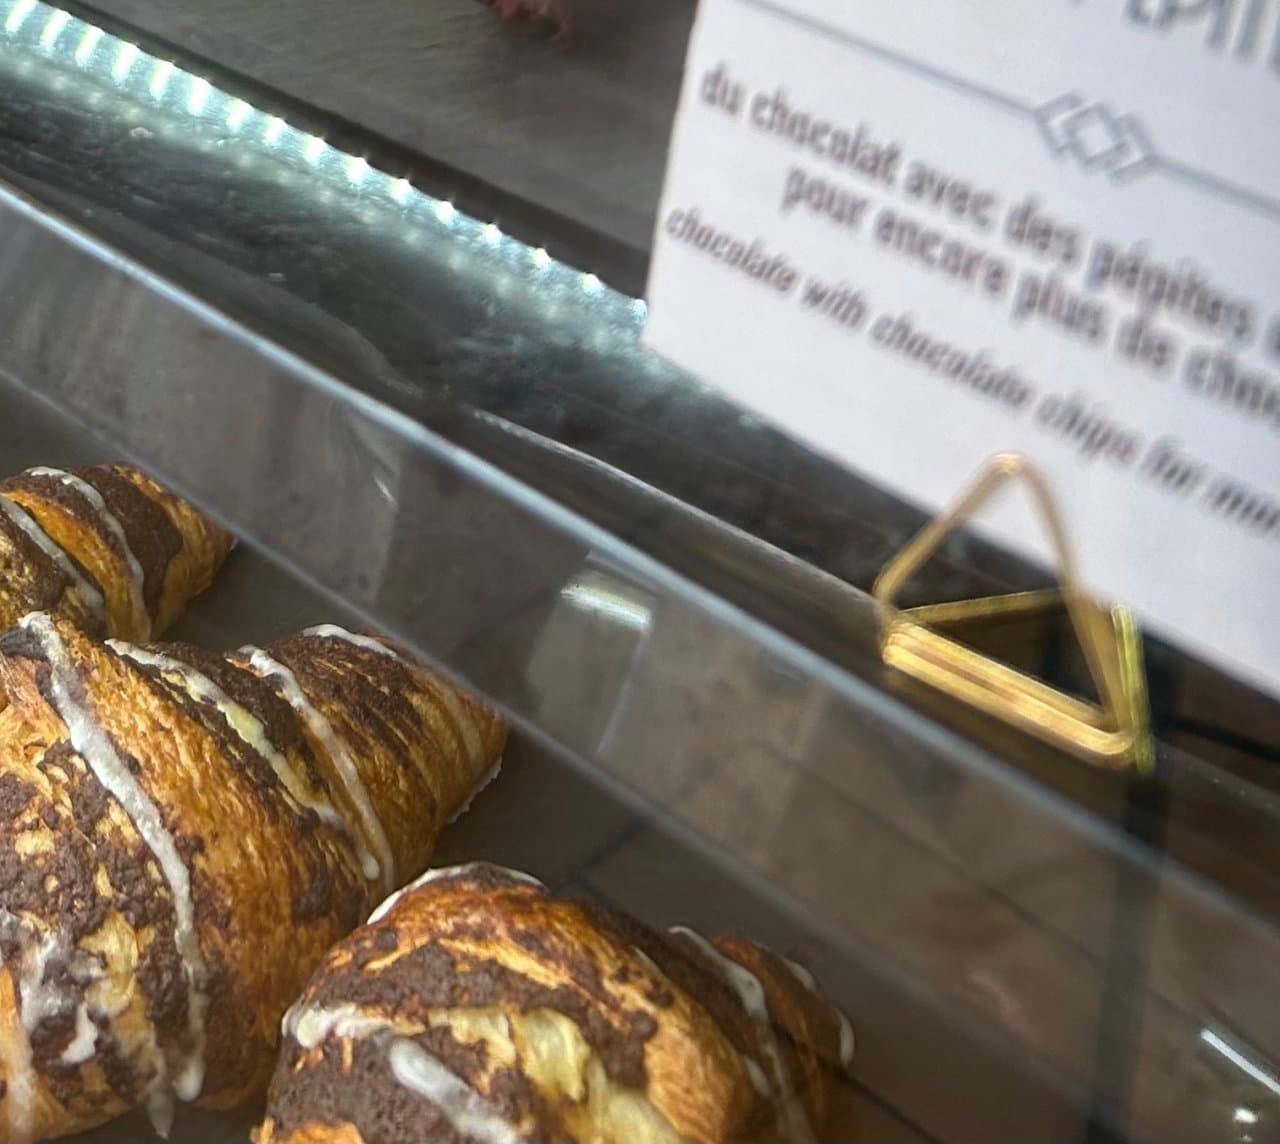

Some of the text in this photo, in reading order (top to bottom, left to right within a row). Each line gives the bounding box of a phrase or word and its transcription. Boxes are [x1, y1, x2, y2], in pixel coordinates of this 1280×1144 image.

[700, 60, 746, 116] du
[749, 85, 903, 188] chocolat
[905, 160, 995, 231] avec
[1003, 196, 1082, 266] des
[665, 205, 799, 295] chocolate
[800, 277, 869, 331] with
[869, 311, 1034, 412] chocolate
[1034, 392, 1142, 467] chips
[779, 164, 869, 230] pour
[873, 206, 1012, 301] encore
[1012, 271, 1107, 346] plus
[1115, 312, 1179, 381] de
